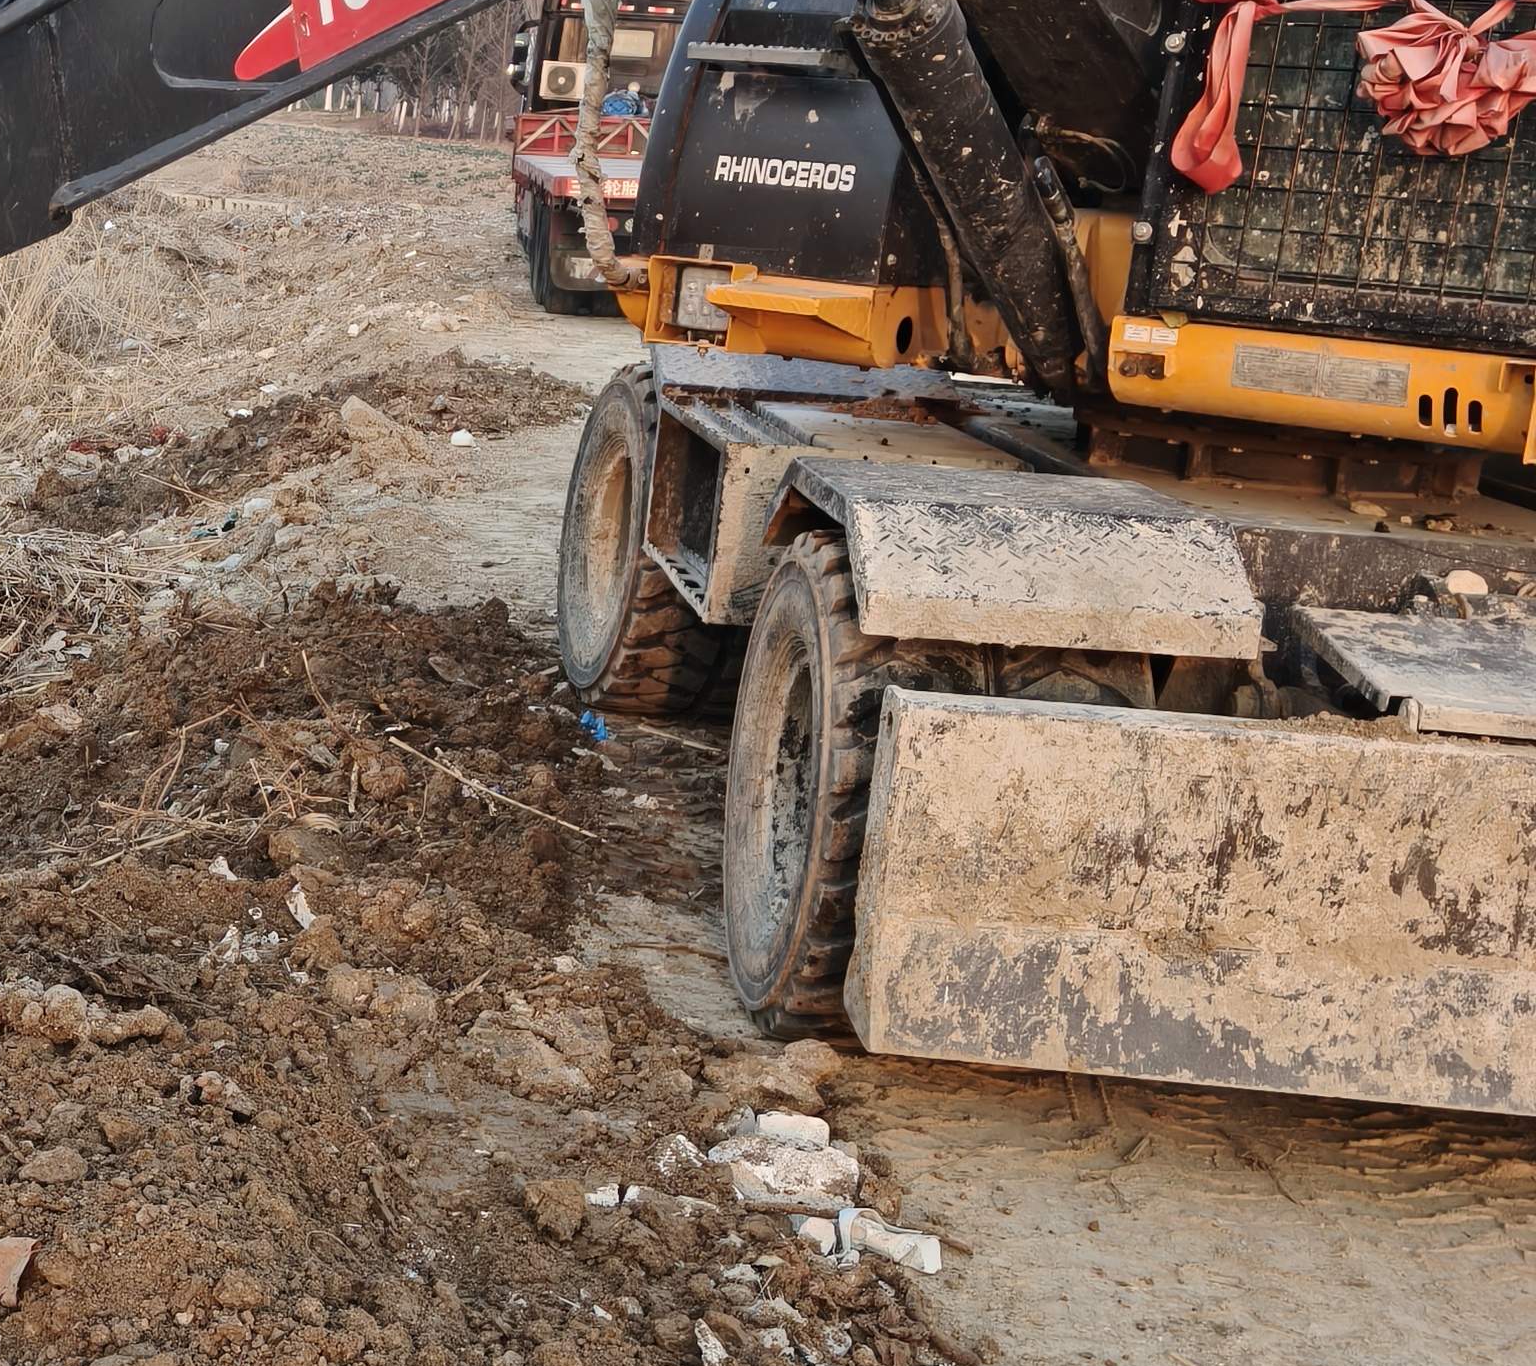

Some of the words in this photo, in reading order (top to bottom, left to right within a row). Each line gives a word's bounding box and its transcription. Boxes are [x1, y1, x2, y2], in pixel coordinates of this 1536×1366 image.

[714, 155, 857, 192] RHINOCEROS
[568, 179, 639, 196] 三轮胎
